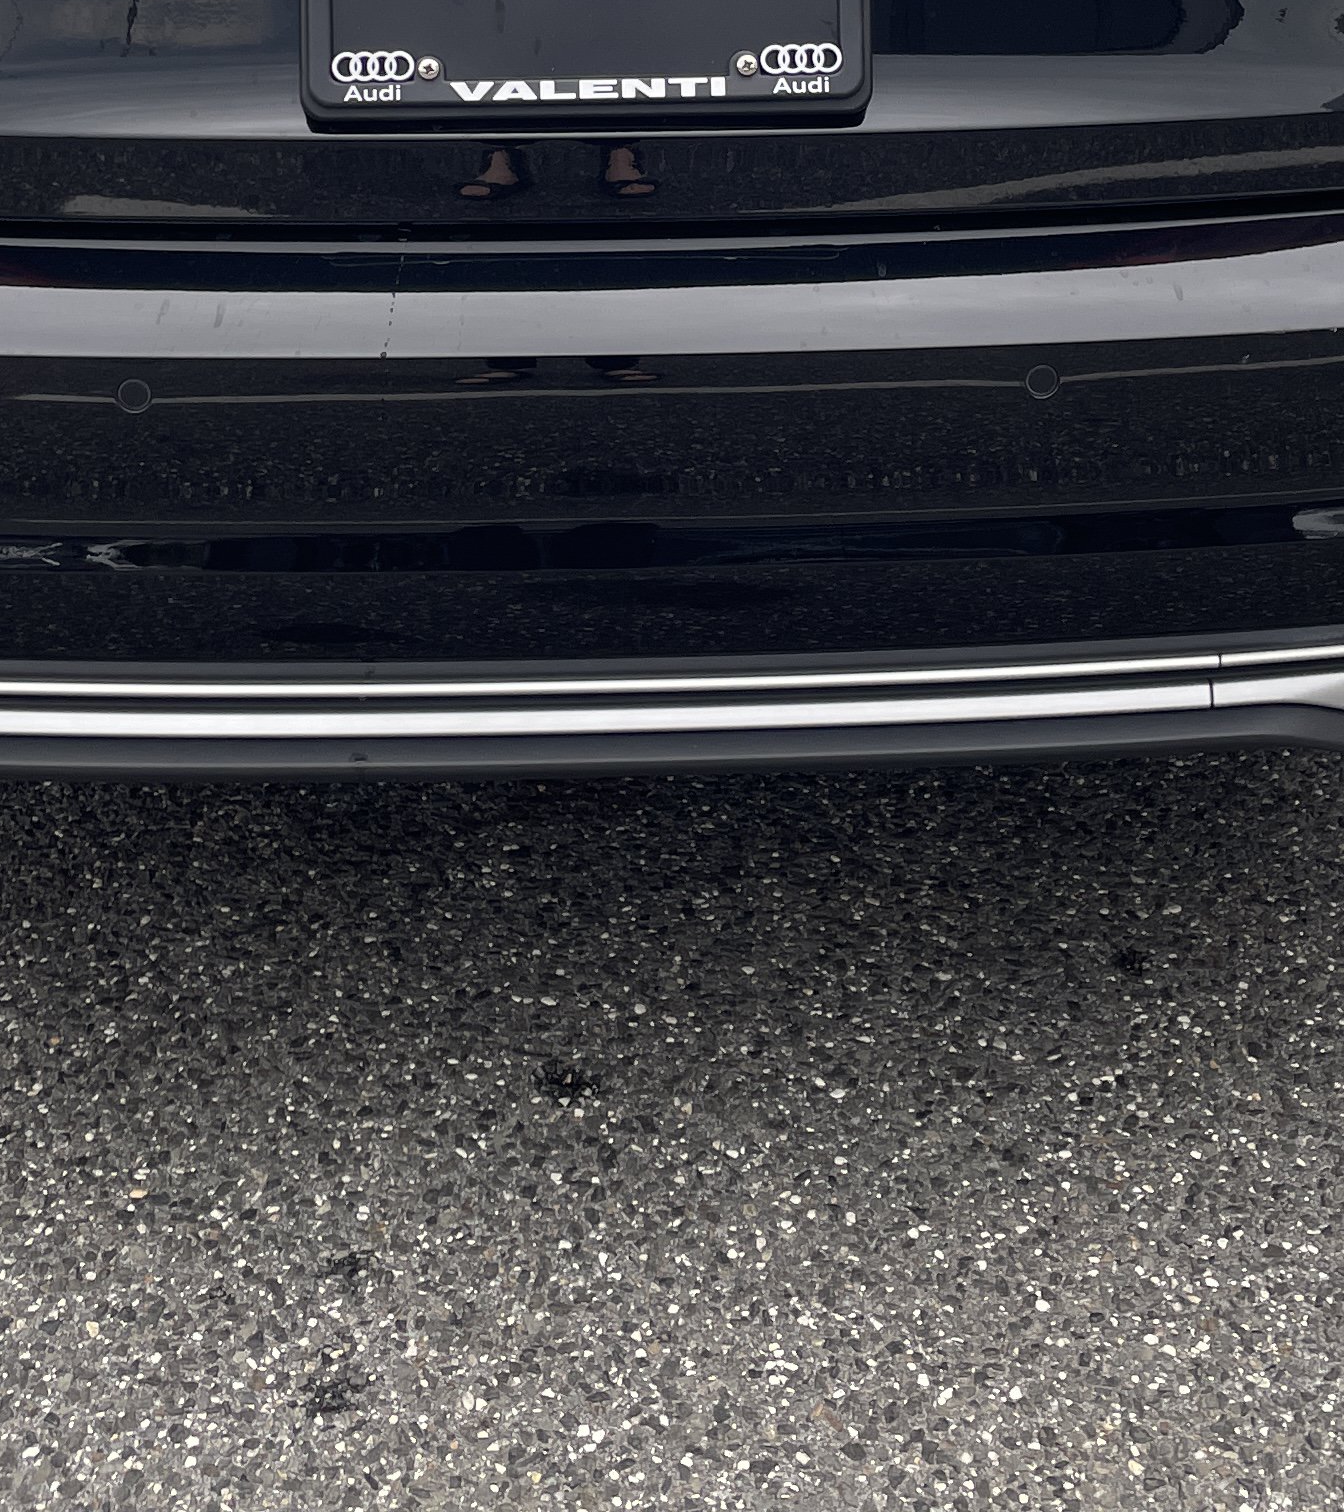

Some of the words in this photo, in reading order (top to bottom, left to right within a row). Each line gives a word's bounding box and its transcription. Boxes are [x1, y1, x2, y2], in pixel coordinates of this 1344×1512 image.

[343, 84, 402, 103] Audi
[448, 76, 727, 103] VALENTI
[773, 75, 830, 95] Audi
